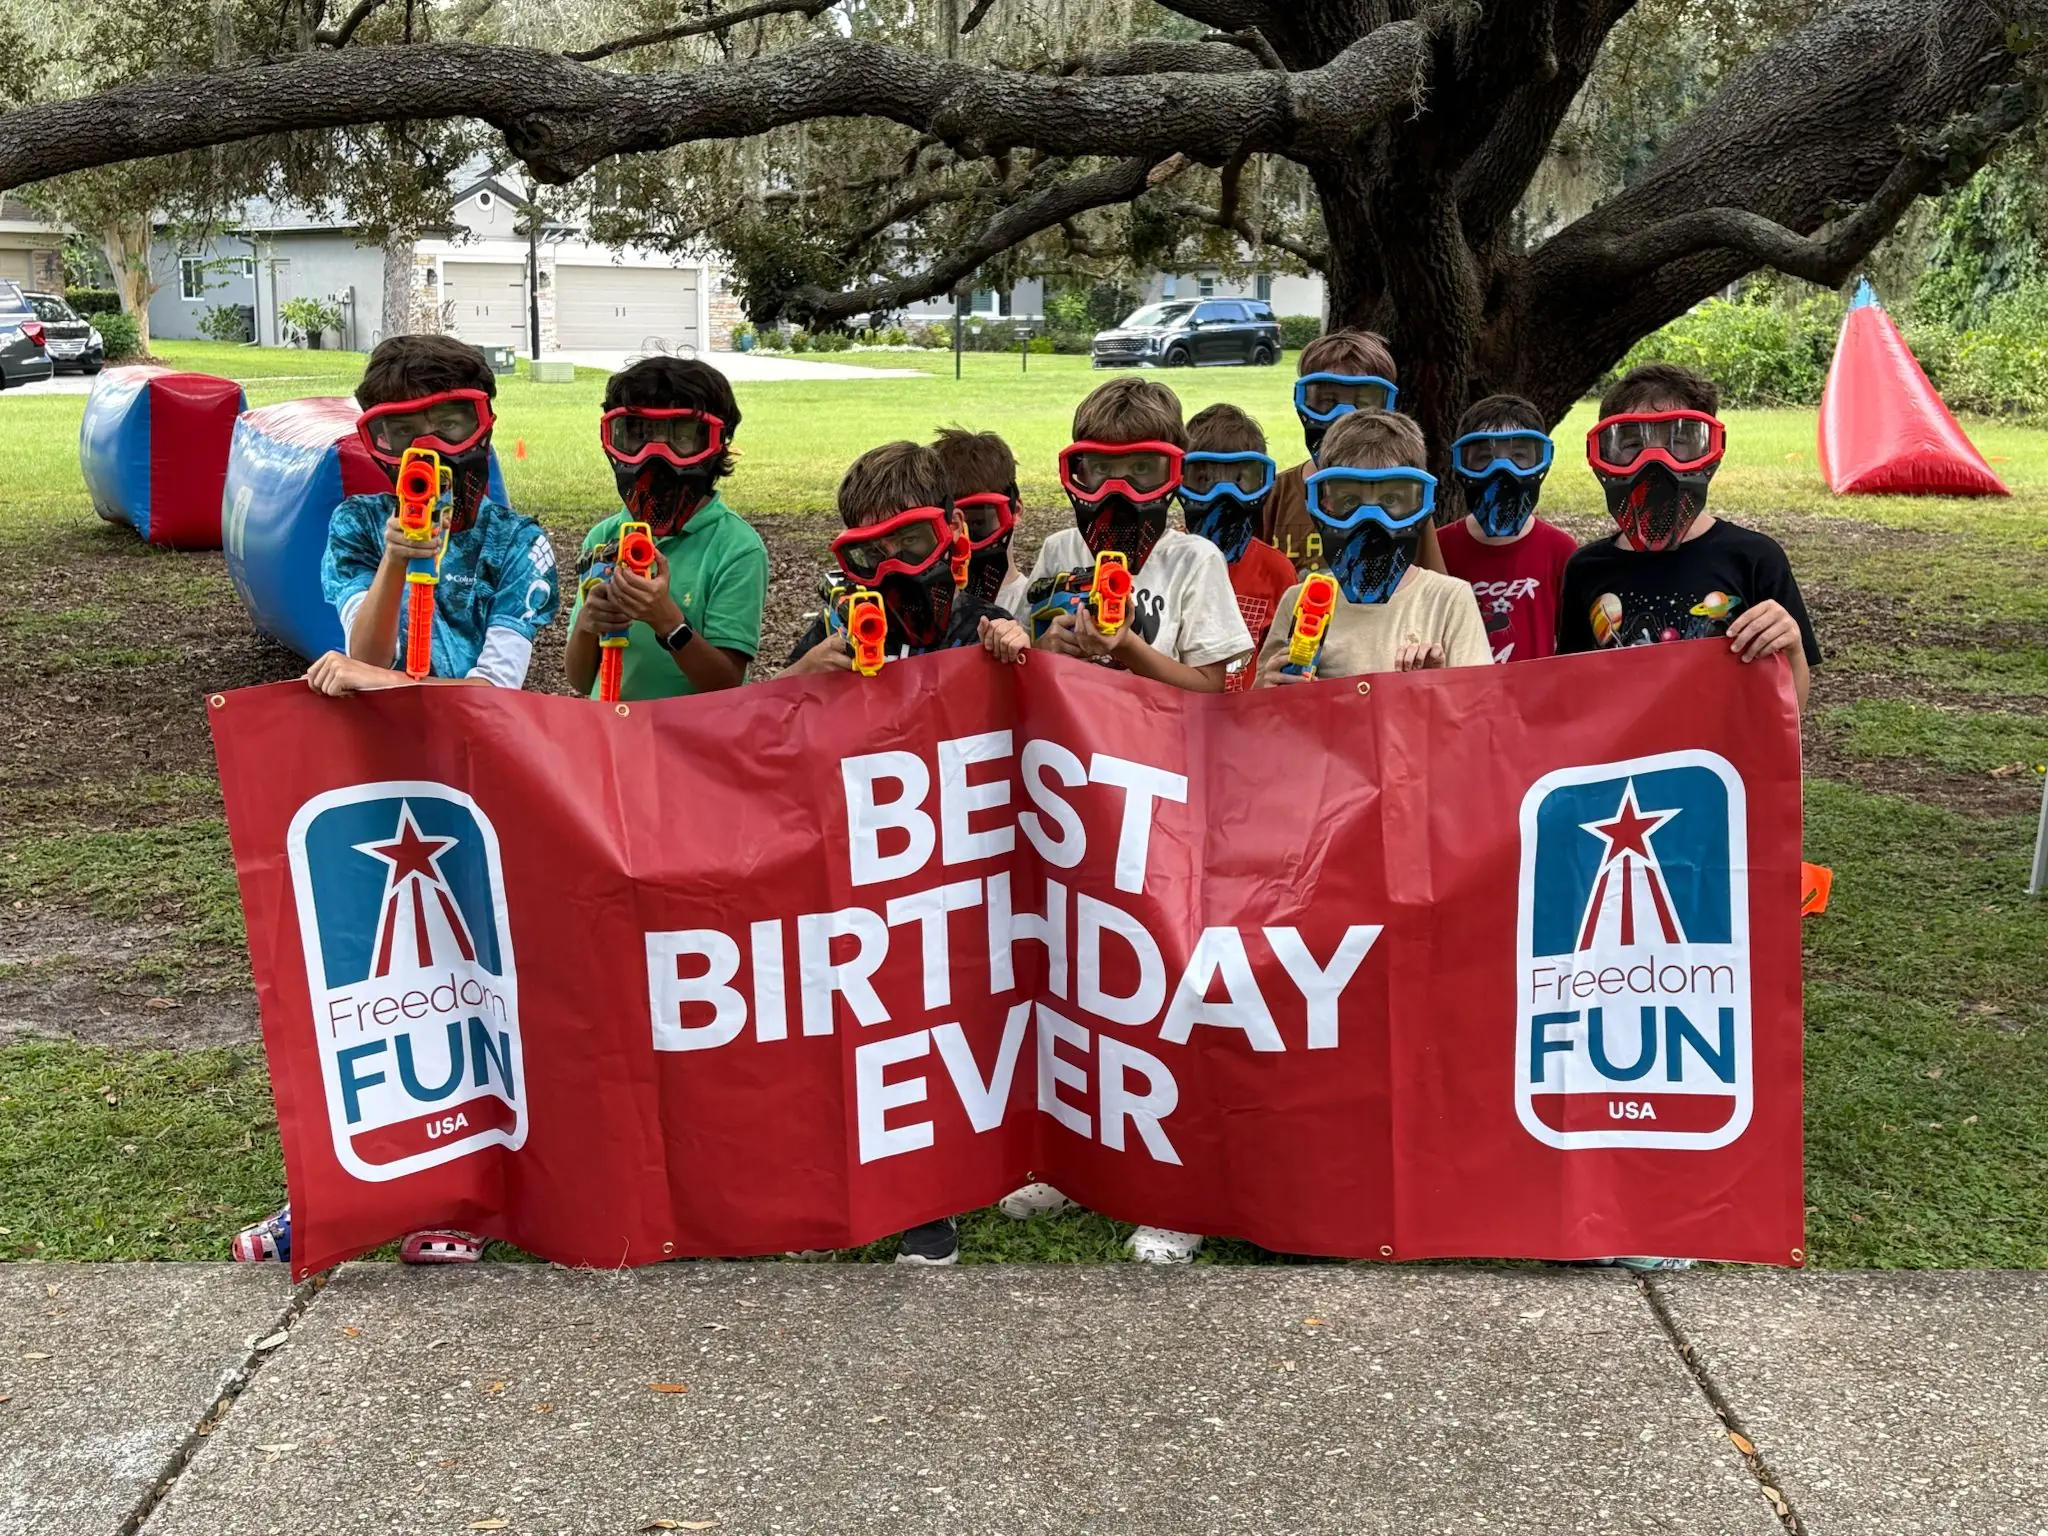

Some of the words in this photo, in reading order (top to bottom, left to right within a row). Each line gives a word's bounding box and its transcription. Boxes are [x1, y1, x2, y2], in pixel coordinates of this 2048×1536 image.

[841, 729, 1188, 894] BEST
[645, 871, 1384, 1052] BIRTHDAY
[1532, 955, 1735, 1004] Freedom
[328, 973, 507, 1038] Freedom
[336, 1016, 516, 1125] FUN
[855, 1000, 1184, 1166] EVER
[1530, 1006, 1736, 1084] FUN
[425, 1112, 469, 1140] USA
[1608, 1101, 1657, 1120] USA
